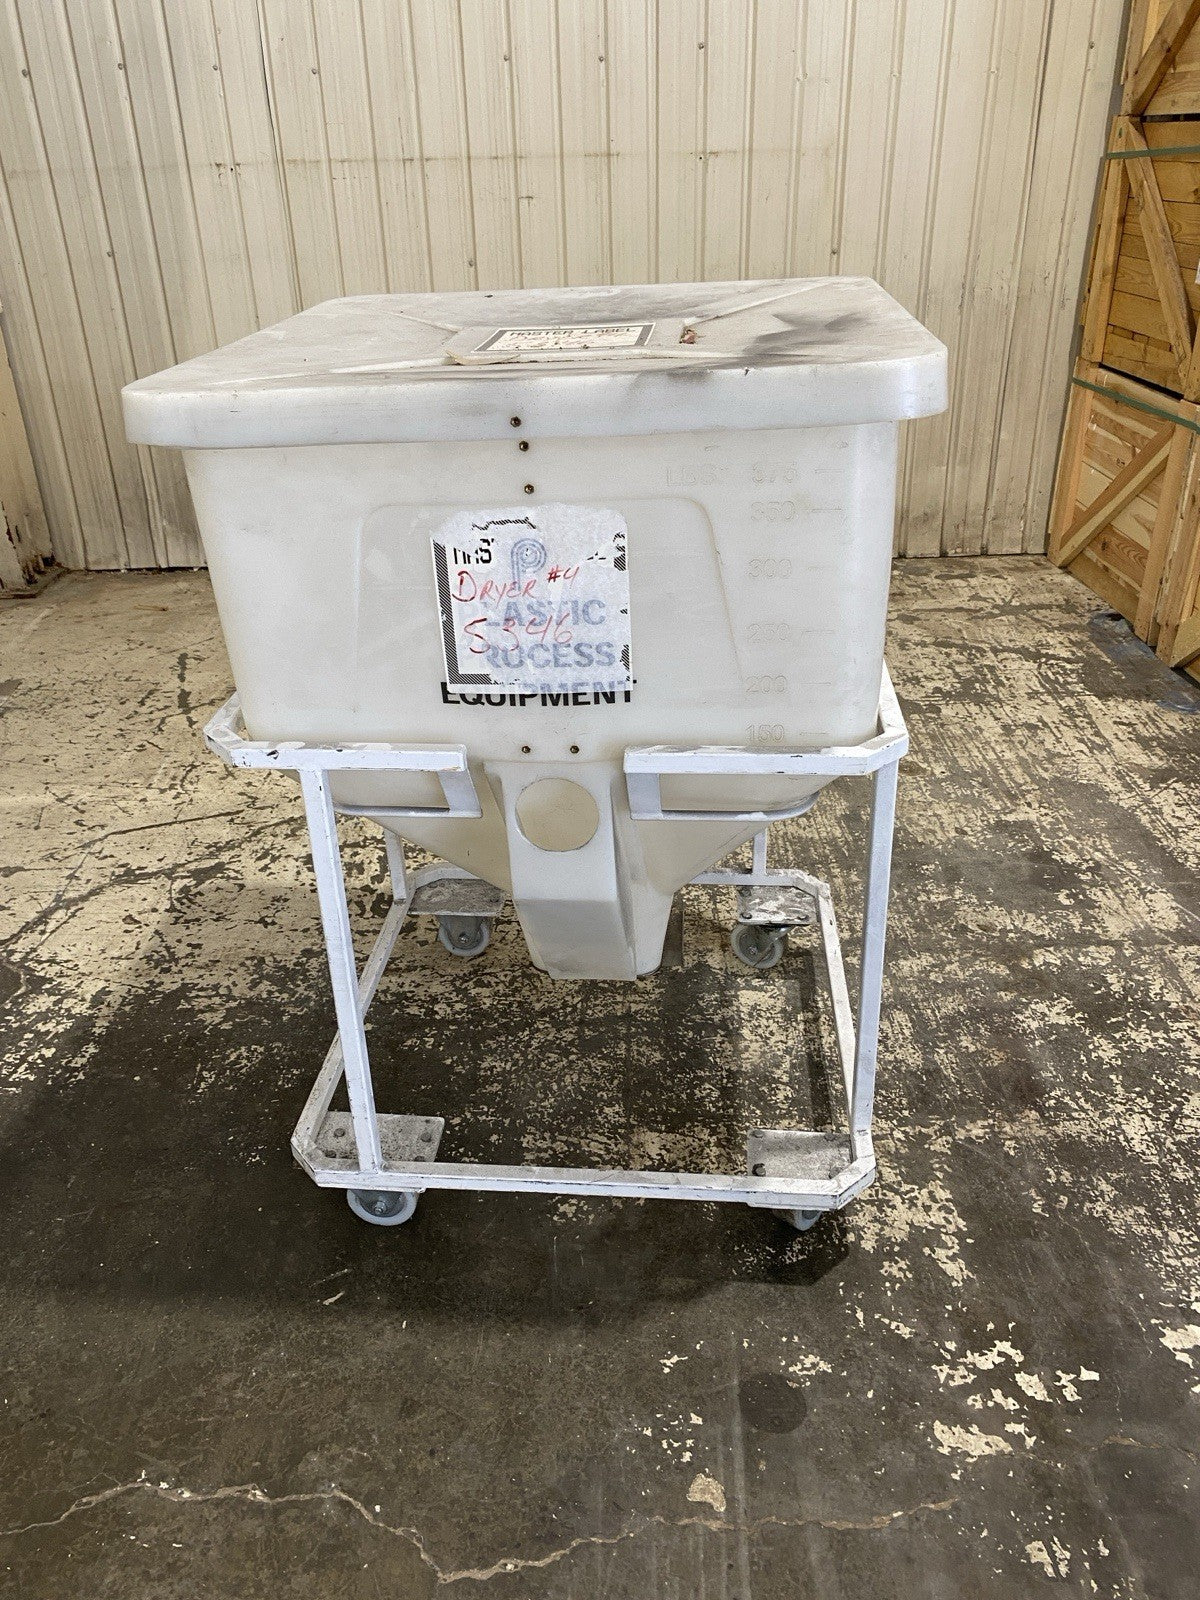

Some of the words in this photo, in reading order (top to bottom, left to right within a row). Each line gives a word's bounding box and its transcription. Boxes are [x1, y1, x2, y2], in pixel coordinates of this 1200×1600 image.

[748, 558, 792, 578] 300
[745, 675, 788, 693] 200
[745, 724, 785, 743] 150
